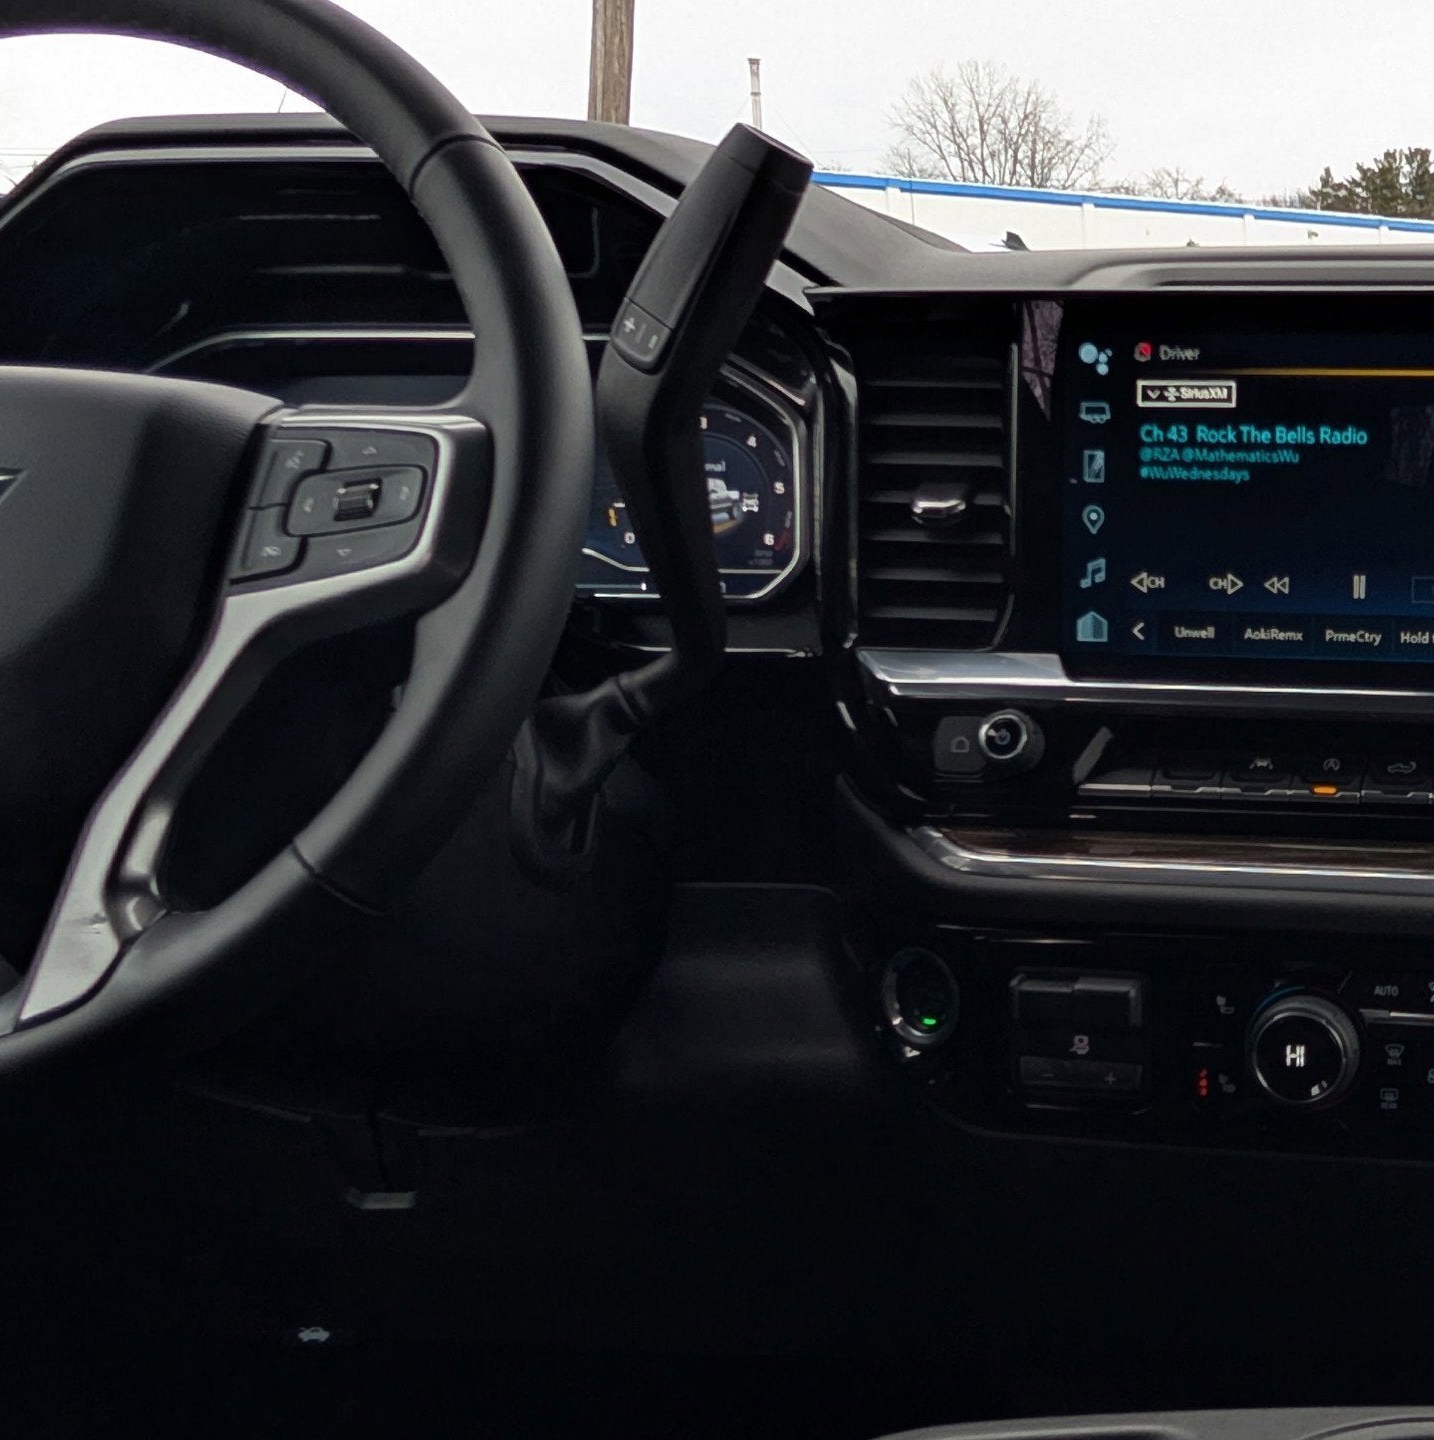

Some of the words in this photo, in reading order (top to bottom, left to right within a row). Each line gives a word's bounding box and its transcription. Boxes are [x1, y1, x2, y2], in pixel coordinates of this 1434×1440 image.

[1159, 345, 1200, 361] Driver
[1180, 386, 1228, 400] SiriusXM
[1140, 423, 1164, 443] Ch
[1166, 424, 1188, 443] 43
[1196, 424, 1237, 444] Rock
[1239, 425, 1271, 444] The
[1275, 425, 1315, 445] Bells
[1319, 425, 1368, 445] Radio
[1147, 576, 1165, 589] CH
[1209, 577, 1227, 590] CH
[1174, 626, 1215, 639] Unwell
[1244, 627, 1304, 641] AokiRemx
[1325, 629, 1382, 646] PrmeCtry
[1400, 631, 1429, 644] Hold
[1374, 984, 1399, 997] AUTO
[1285, 1044, 1305, 1067] HI
